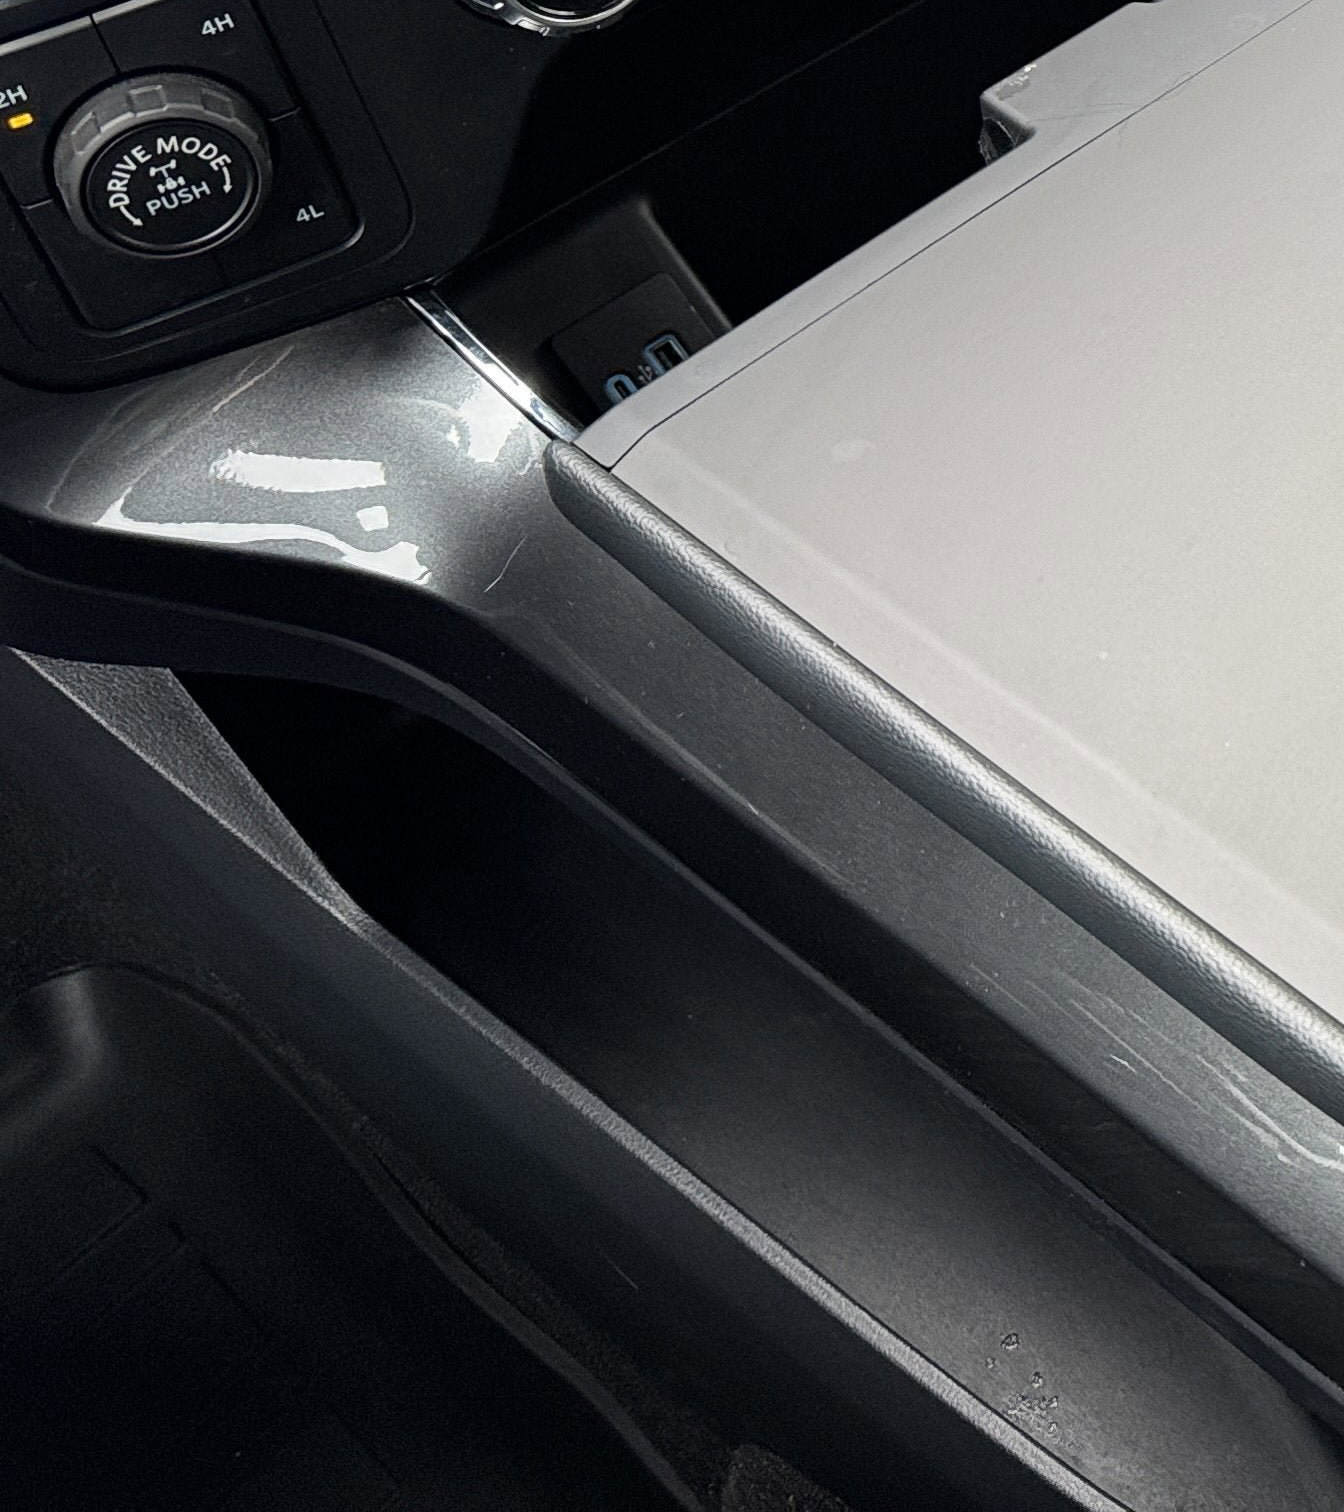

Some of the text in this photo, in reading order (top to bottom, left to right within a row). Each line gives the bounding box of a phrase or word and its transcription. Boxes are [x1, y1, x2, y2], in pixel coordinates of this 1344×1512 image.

[201, 12, 236, 37] 4H
[0, 84, 28, 109] 2H
[107, 135, 233, 209] DRIVE MODE
[145, 181, 212, 217] PUSH
[295, 203, 326, 223] 4L
